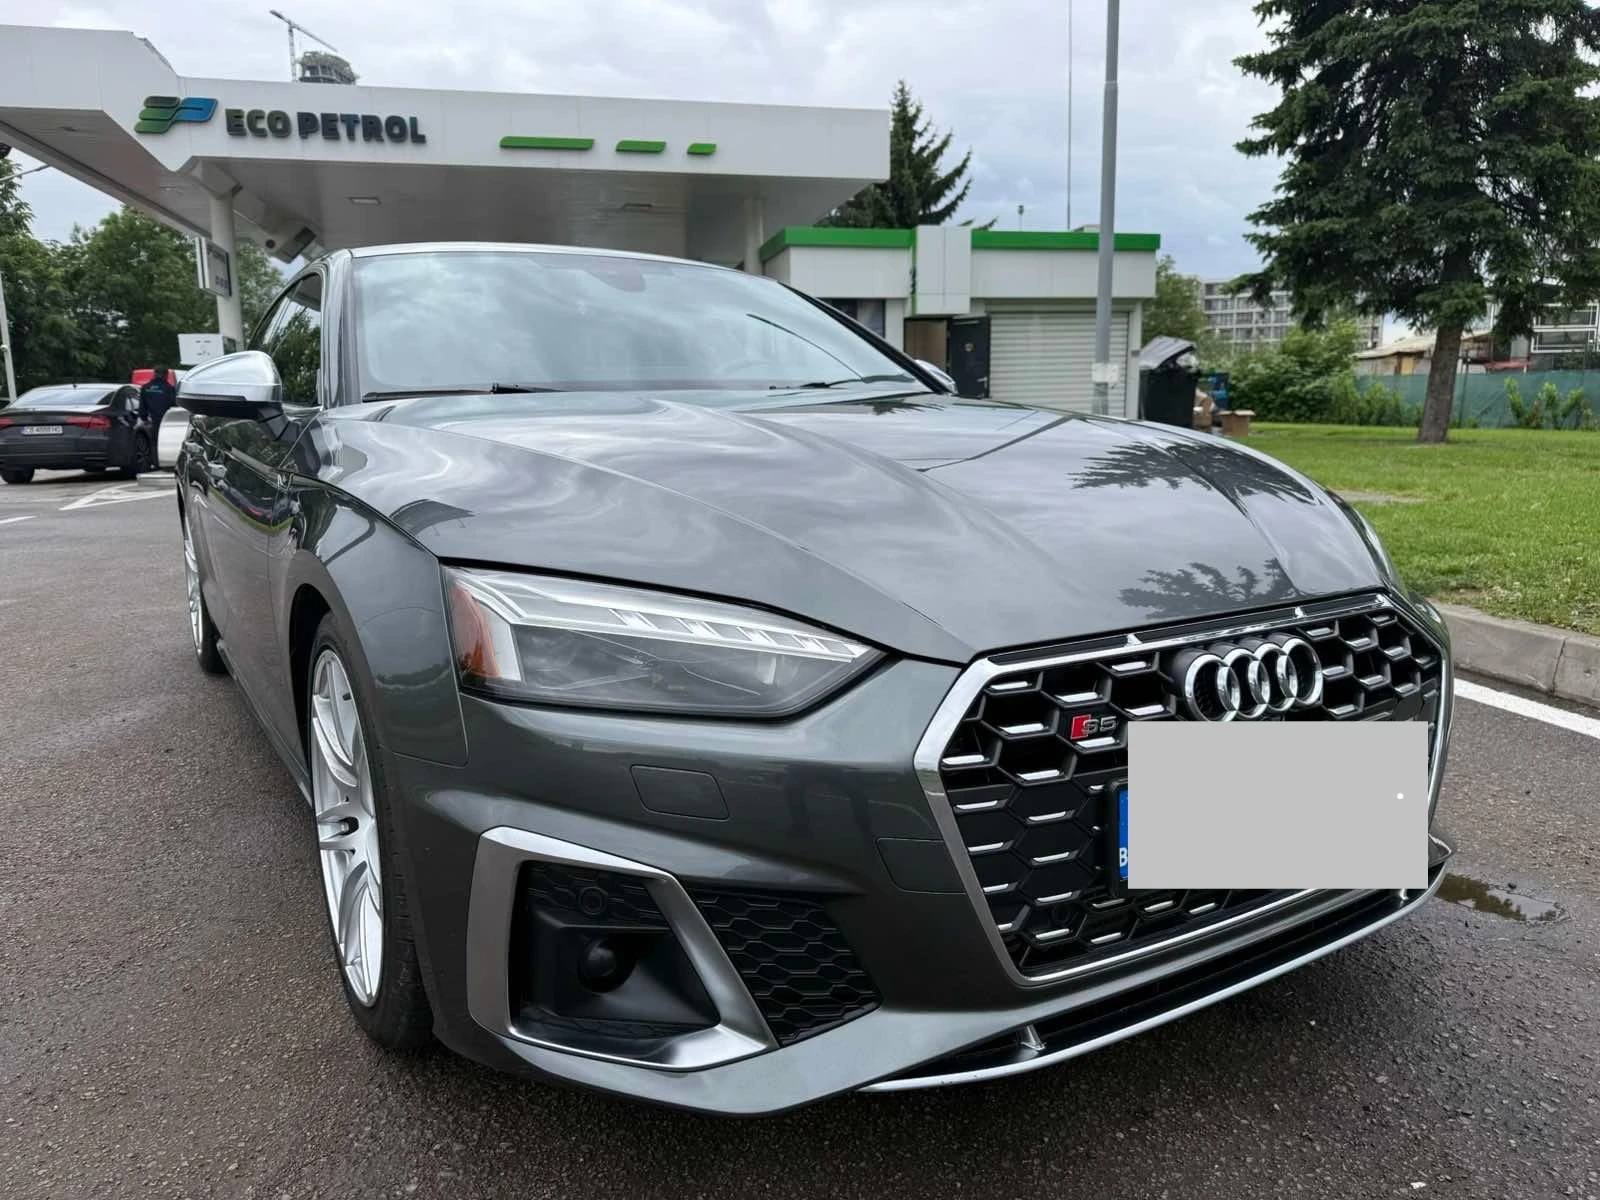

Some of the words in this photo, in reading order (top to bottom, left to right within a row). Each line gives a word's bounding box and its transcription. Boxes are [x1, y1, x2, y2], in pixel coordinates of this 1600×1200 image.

[225, 108, 291, 138] ECO
[297, 111, 427, 144] PETROL
[1082, 716, 1117, 733] S5
